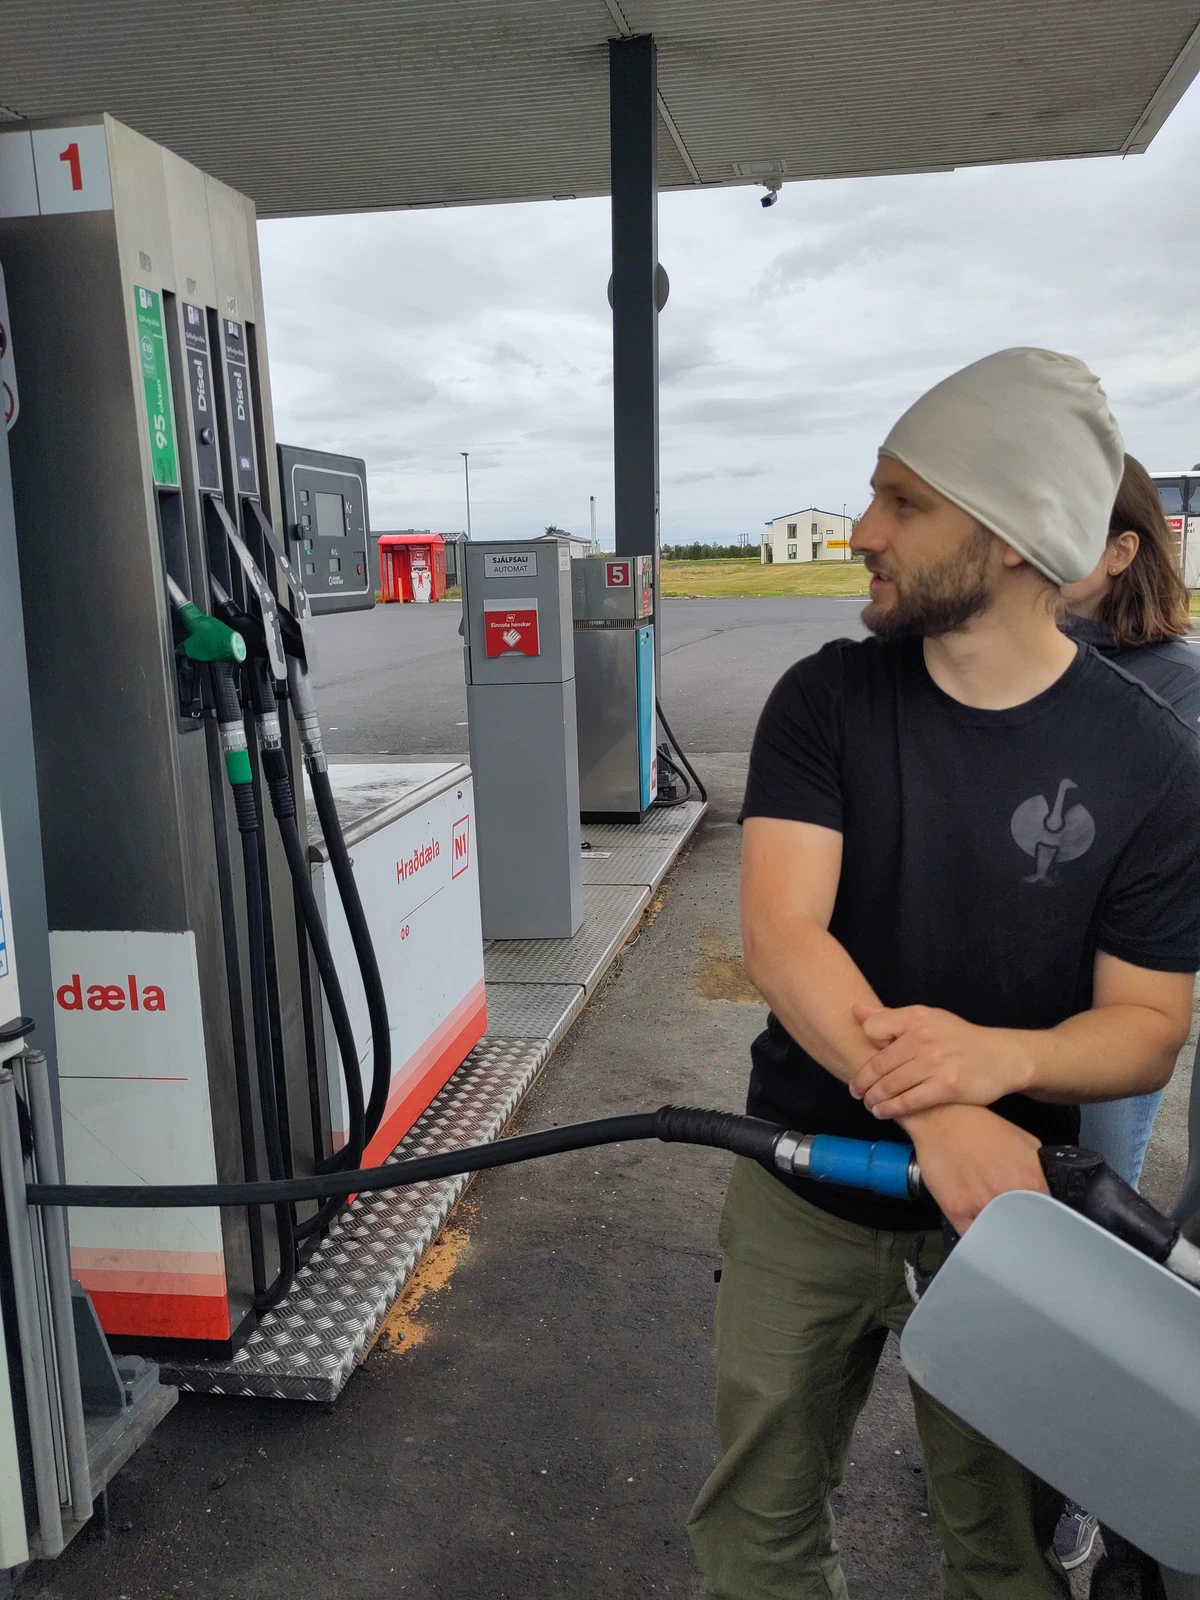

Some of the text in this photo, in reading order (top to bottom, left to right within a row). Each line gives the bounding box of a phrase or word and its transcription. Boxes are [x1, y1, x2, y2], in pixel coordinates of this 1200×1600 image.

[59, 143, 83, 191] 1
[193, 359, 207, 412] Dísel
[233, 372, 246, 421] Dísel
[154, 379, 168, 450] 95 oktan
[492, 555, 528, 564] SJÁLFSALI
[493, 565, 528, 573] AUTOMAT
[611, 566, 624, 584] 5
[396, 832, 467, 884] Hraðdæla N1
[56, 974, 166, 1011] dæla
